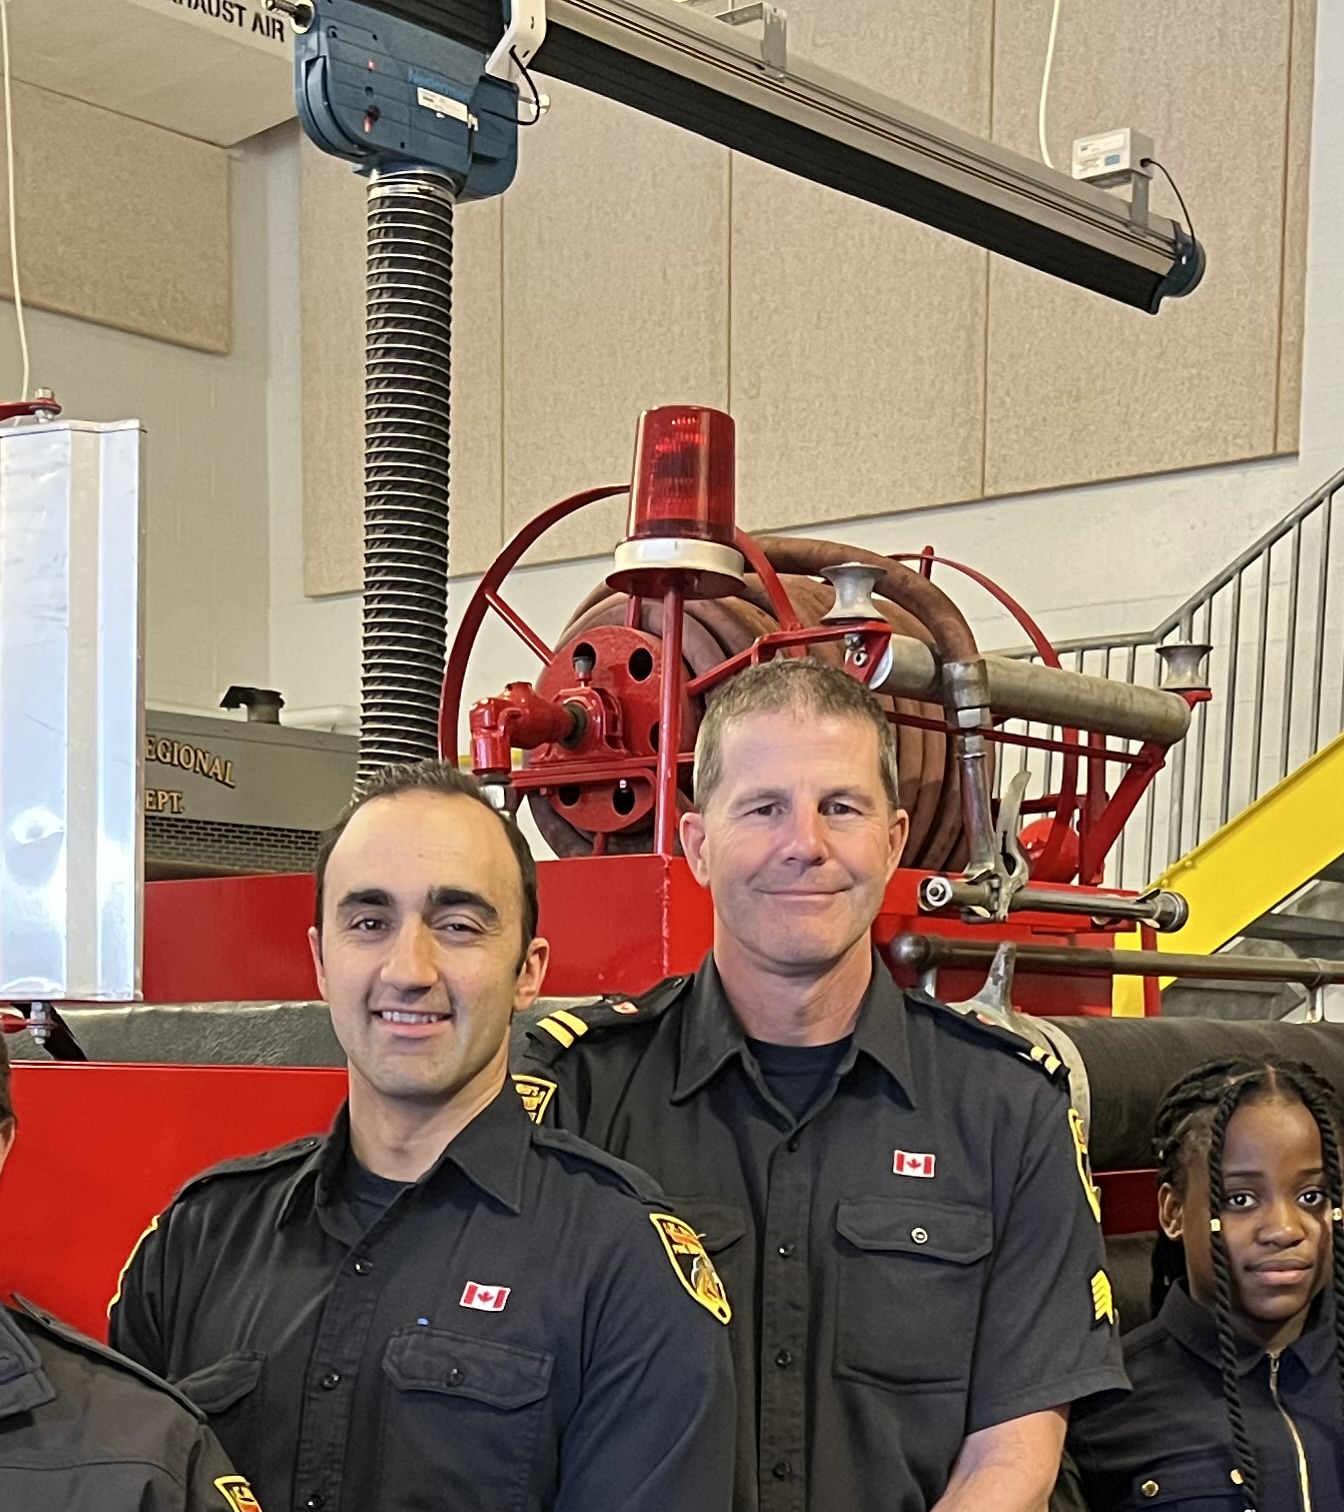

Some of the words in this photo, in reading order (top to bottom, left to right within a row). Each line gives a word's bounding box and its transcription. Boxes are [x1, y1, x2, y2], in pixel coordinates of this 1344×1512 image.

[252, 12, 285, 43] AIR
[146, 735, 236, 788] EGIONAL
[146, 789, 185, 814] EPT.
